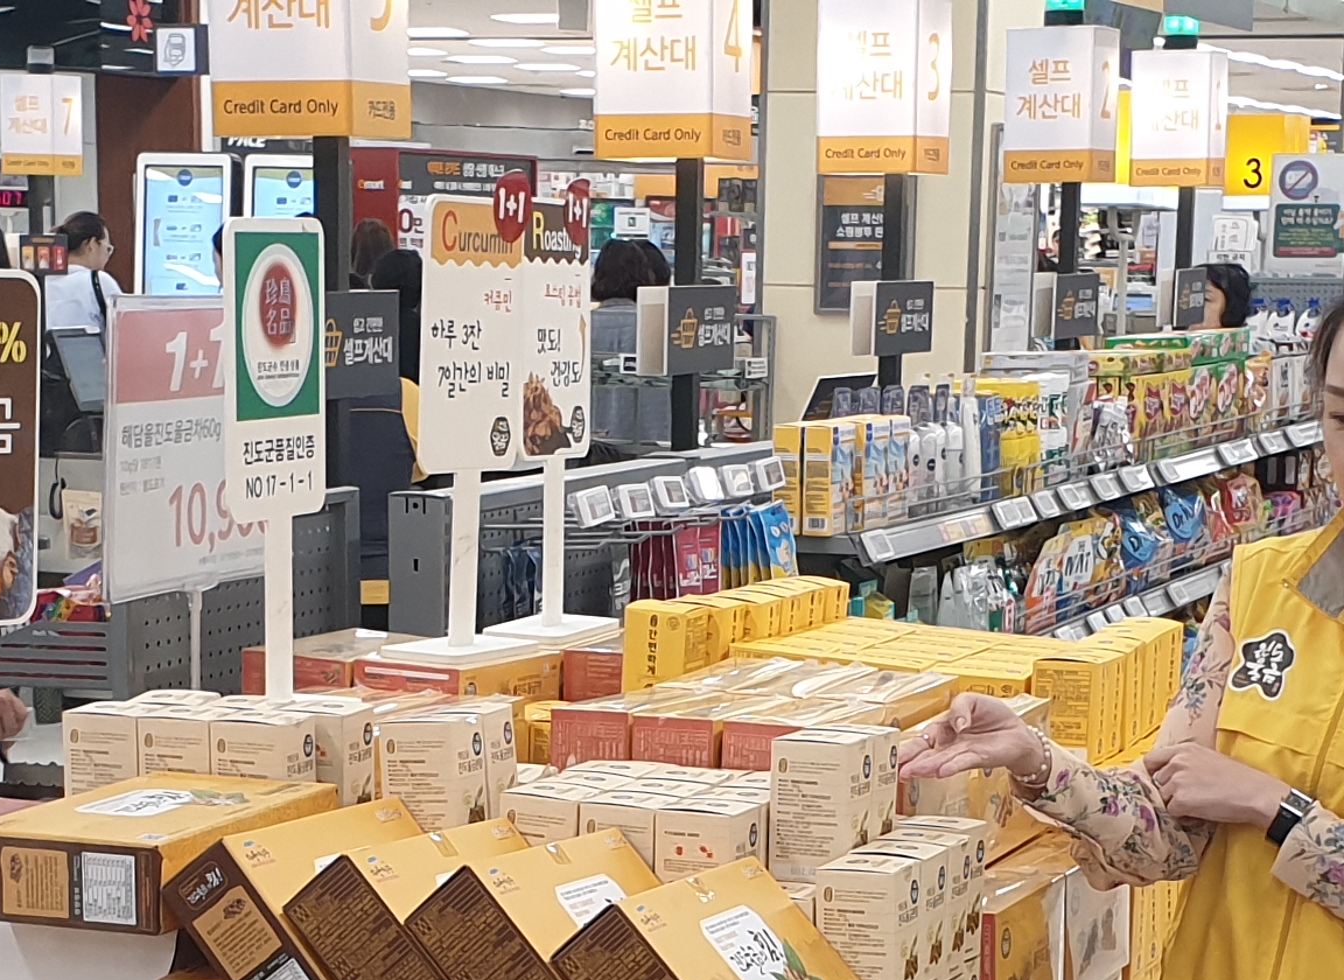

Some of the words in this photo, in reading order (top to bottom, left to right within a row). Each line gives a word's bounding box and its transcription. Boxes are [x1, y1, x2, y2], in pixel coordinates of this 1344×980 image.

[611, 36, 696, 71] 계산대
[927, 32, 941, 101] 3
[1028, 59, 1071, 85] 셀프
[61, 97, 75, 135] 7
[224, 99, 265, 114] Credit
[270, 99, 302, 114] Card
[307, 99, 338, 117] Only
[1016, 93, 1081, 120] 계산대
[605, 128, 639, 140] Credit
[644, 128, 670, 140] Card
[675, 128, 701, 143] Only
[825, 148, 854, 159] Credit
[857, 148, 881, 159] Card
[884, 148, 906, 160] Only
[1011, 160, 1037, 170] Credit
[1040, 160, 1060, 169] Card
[1064, 160, 1083, 171] Only
[1243, 157, 1263, 189] 3
[498, 187, 526, 224] 1+1
[431, 319, 457, 349] 하루
[461, 320, 482, 350] 3잔
[343, 336, 393, 366] 셀프계산대
[438, 361, 482, 398] 7일간의
[487, 361, 510, 398] 비밀
[243, 435, 316, 465] 진도군품질인증
[246, 475, 263, 499] NO
